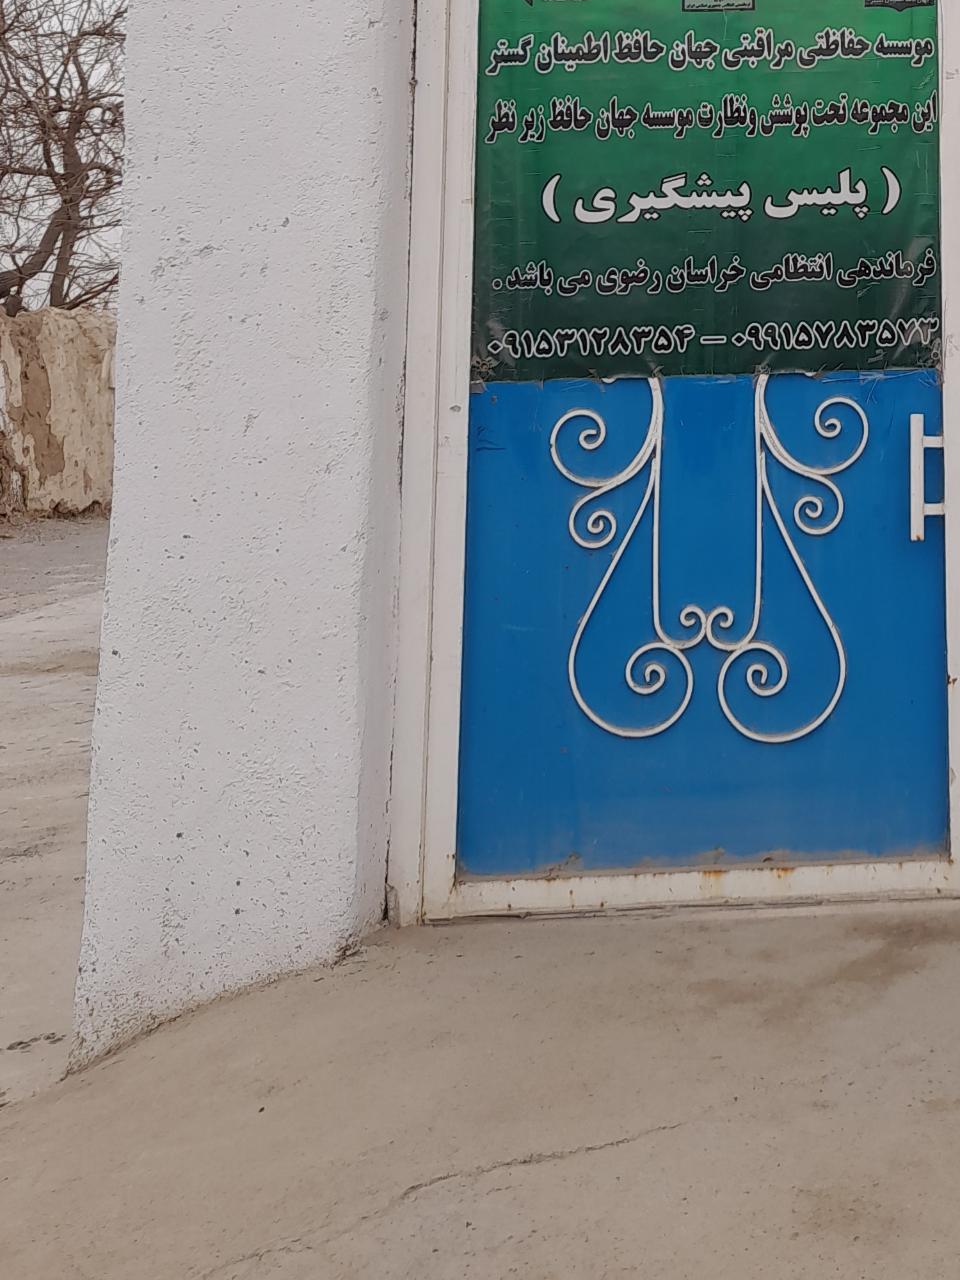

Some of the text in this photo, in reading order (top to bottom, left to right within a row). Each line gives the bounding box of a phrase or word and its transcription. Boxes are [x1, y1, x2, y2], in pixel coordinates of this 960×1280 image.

[485, 27, 934, 75] موسسه حفاظتی مراقبتی جهان حافظ اطمینان گستر
[485, 98, 517, 144] نظر
[519, 104, 545, 143] زیر
[548, 95, 593, 131] حافظ
[595, 96, 639, 140] جهان
[641, 102, 694, 138] موسسه
[759, 93, 810, 138] پوشش
[811, 93, 848, 126] تحت
[851, 99, 909, 134] مجموعه
[912, 89, 938, 133] این
[573, 172, 752, 224] پیشگیری
[764, 167, 868, 220] پلیس
[506, 260, 553, 295] باشد
[557, 269, 592, 296] می
[596, 258, 663, 295] رضوی
[666, 255, 746, 293] خراسان
[750, 251, 833, 291] انتظامی
[836, 248, 937, 288] فرماندهی
[487, 324, 696, 359] ۰۹۱۵۳۱۲۸۳۵۴
[732, 317, 940, 351] ۰۹۹۱۵۷۸۳۵۷۳
